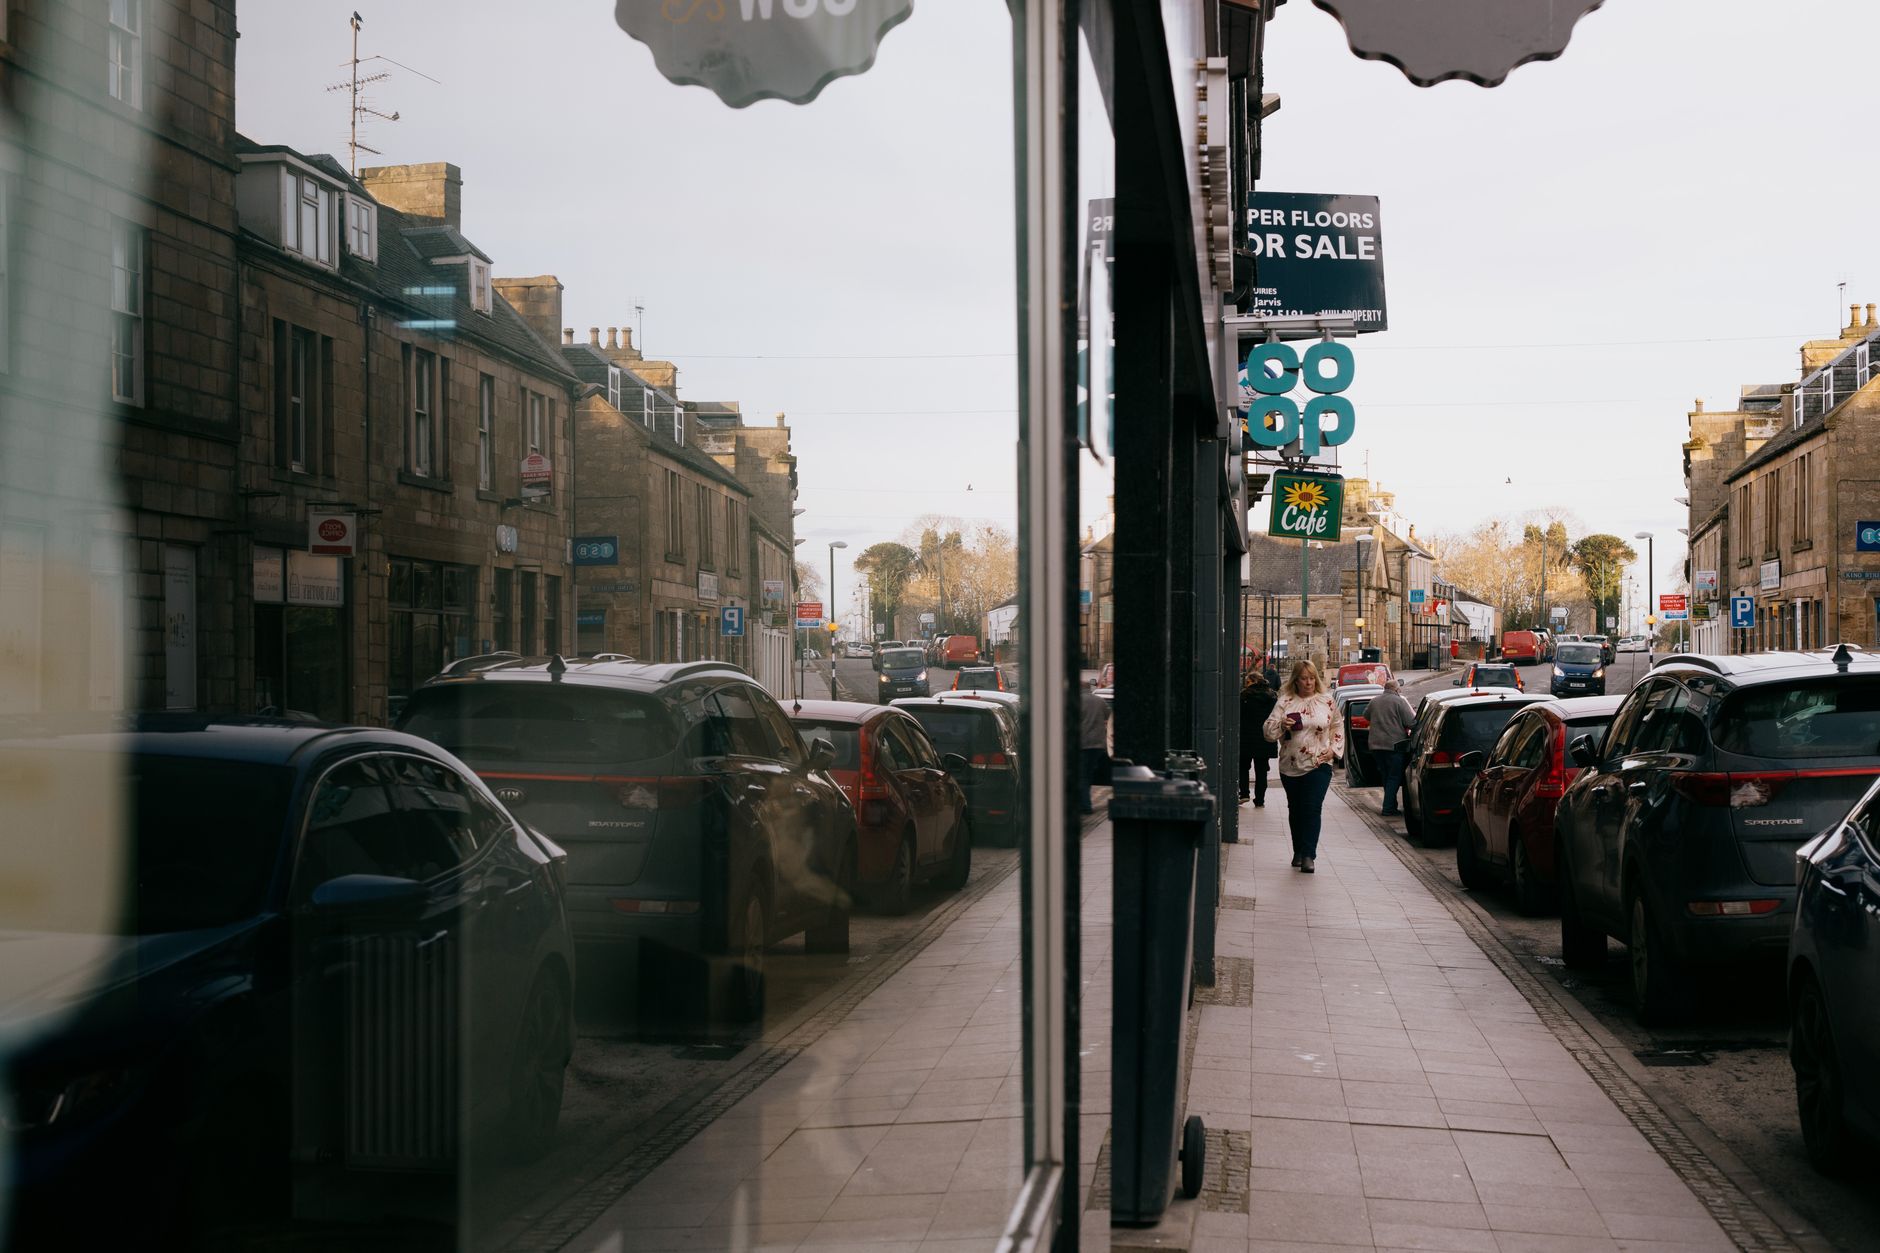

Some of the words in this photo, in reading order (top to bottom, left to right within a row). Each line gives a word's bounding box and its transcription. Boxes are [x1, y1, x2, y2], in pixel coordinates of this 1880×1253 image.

[1291, 210, 1374, 229] FLOORS
[1294, 234, 1376, 260] SALE
[1253, 296, 1282, 308] Jarvis
[1281, 505, 1327, 535] Café
[1736, 599, 1751, 619] P
[1744, 818, 1804, 826] SPORTAGE
